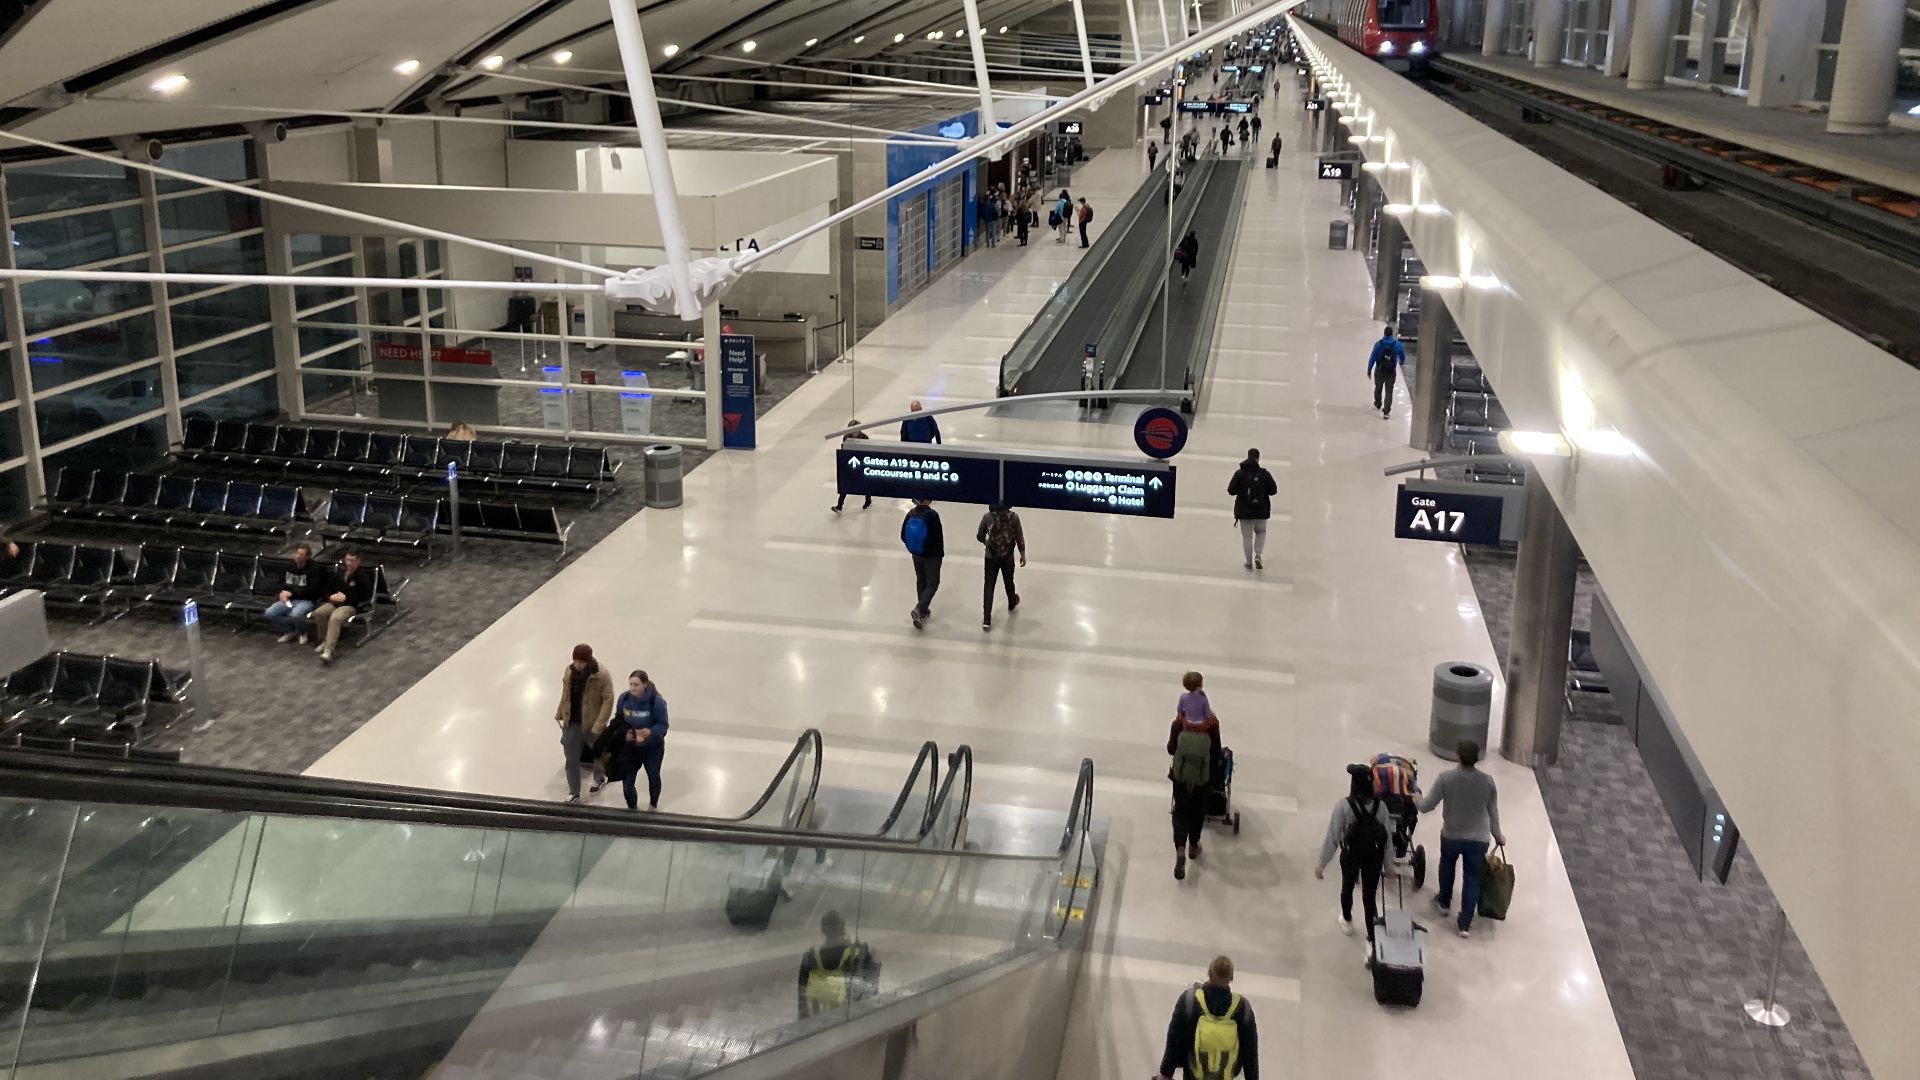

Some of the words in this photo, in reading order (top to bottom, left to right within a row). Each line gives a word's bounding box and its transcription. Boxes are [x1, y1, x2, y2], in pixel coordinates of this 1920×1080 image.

[1322, 168, 1342, 177] A19
[380, 347, 408, 359] NEED
[729, 356, 747, 364] Help?
[863, 456, 889, 467] Gates
[890, 458, 908, 468] A19
[909, 460, 920, 468] to
[921, 460, 939, 470] A78
[863, 467, 914, 479] Concourses
[915, 470, 921, 479] B
[923, 471, 940, 481] and
[942, 472, 949, 481] C
[1103, 472, 1145, 484] Terminal
[1075, 482, 1116, 495] Luggage
[1118, 484, 1144, 496] Claim
[1118, 495, 1145, 506] Hotel
[1411, 496, 1436, 507] Gate
[1409, 508, 1465, 532] A17
